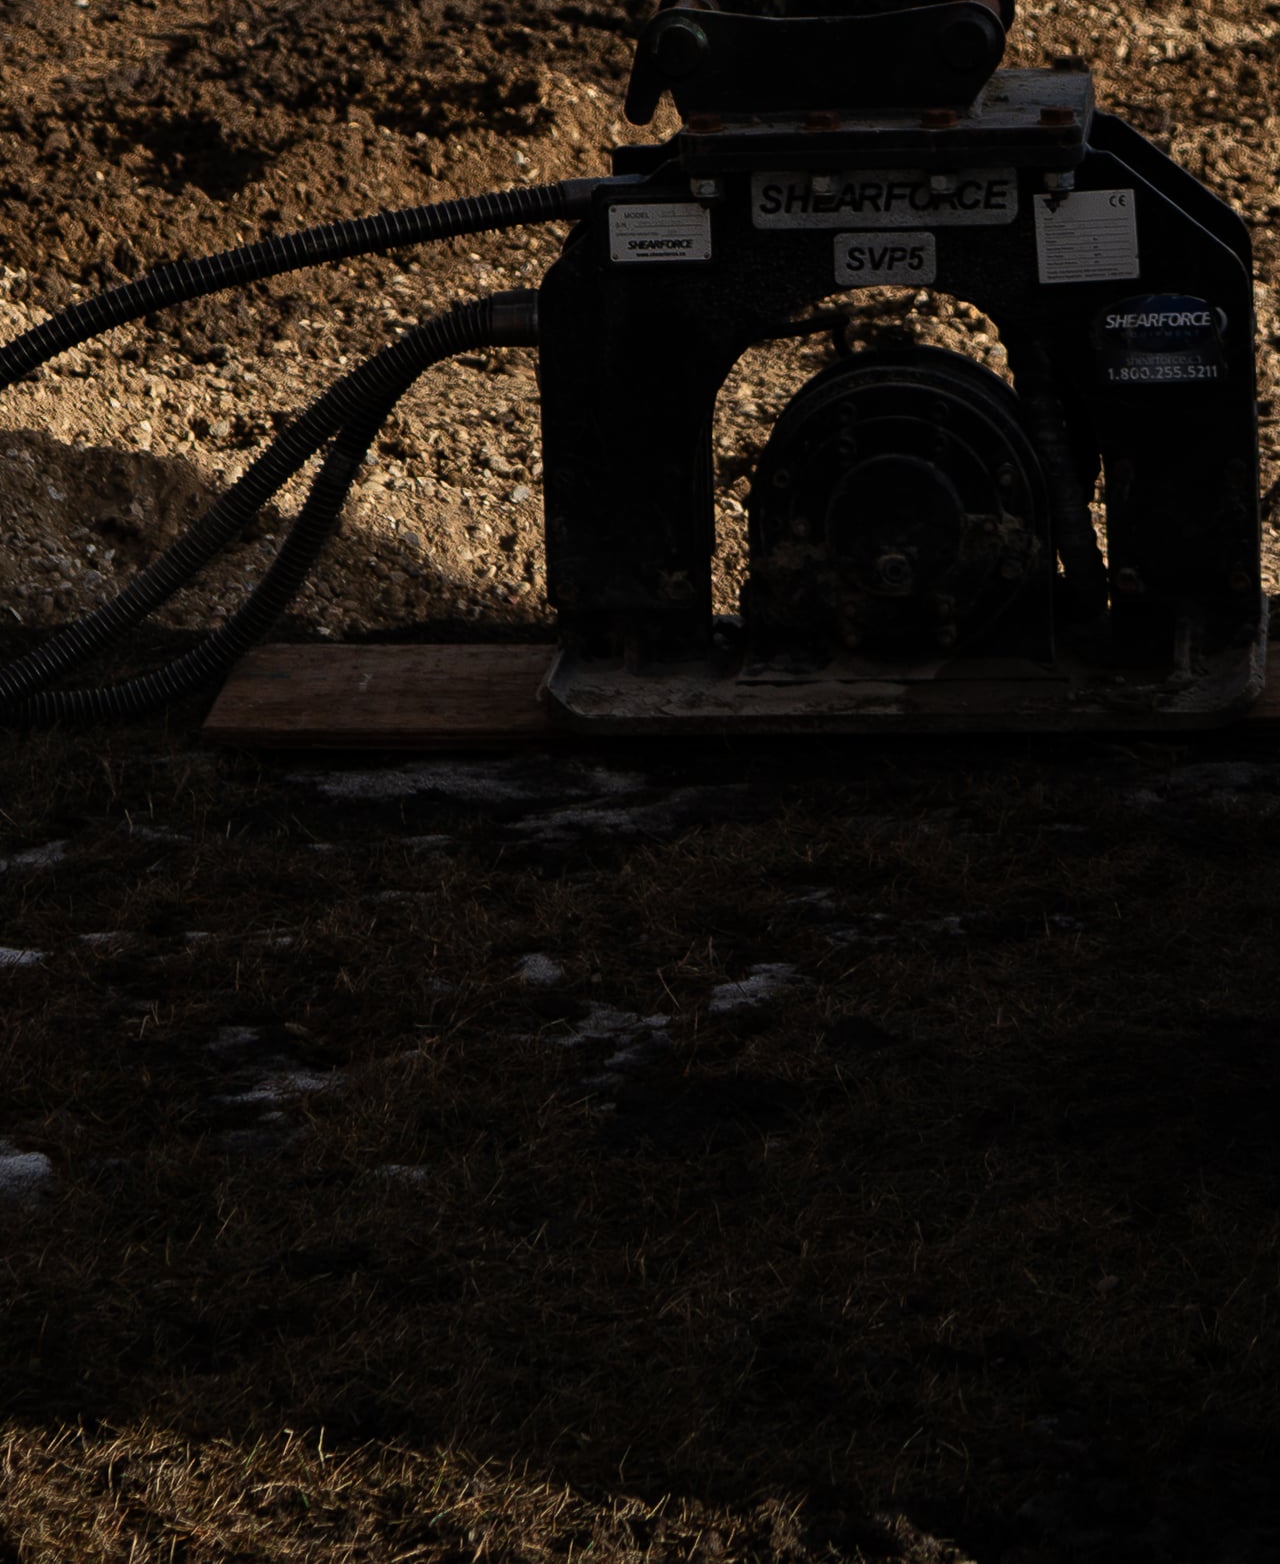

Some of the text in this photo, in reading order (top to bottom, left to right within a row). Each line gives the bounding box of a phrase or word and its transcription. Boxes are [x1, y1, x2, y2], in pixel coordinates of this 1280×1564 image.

[760, 180, 1010, 214] SHEARFORCE
[628, 239, 694, 249] SHEARFORCE
[846, 247, 924, 271] SVP5
[1105, 312, 1212, 329] SHEARFORCE
[1107, 365, 1218, 380] 1.800.255.5211
